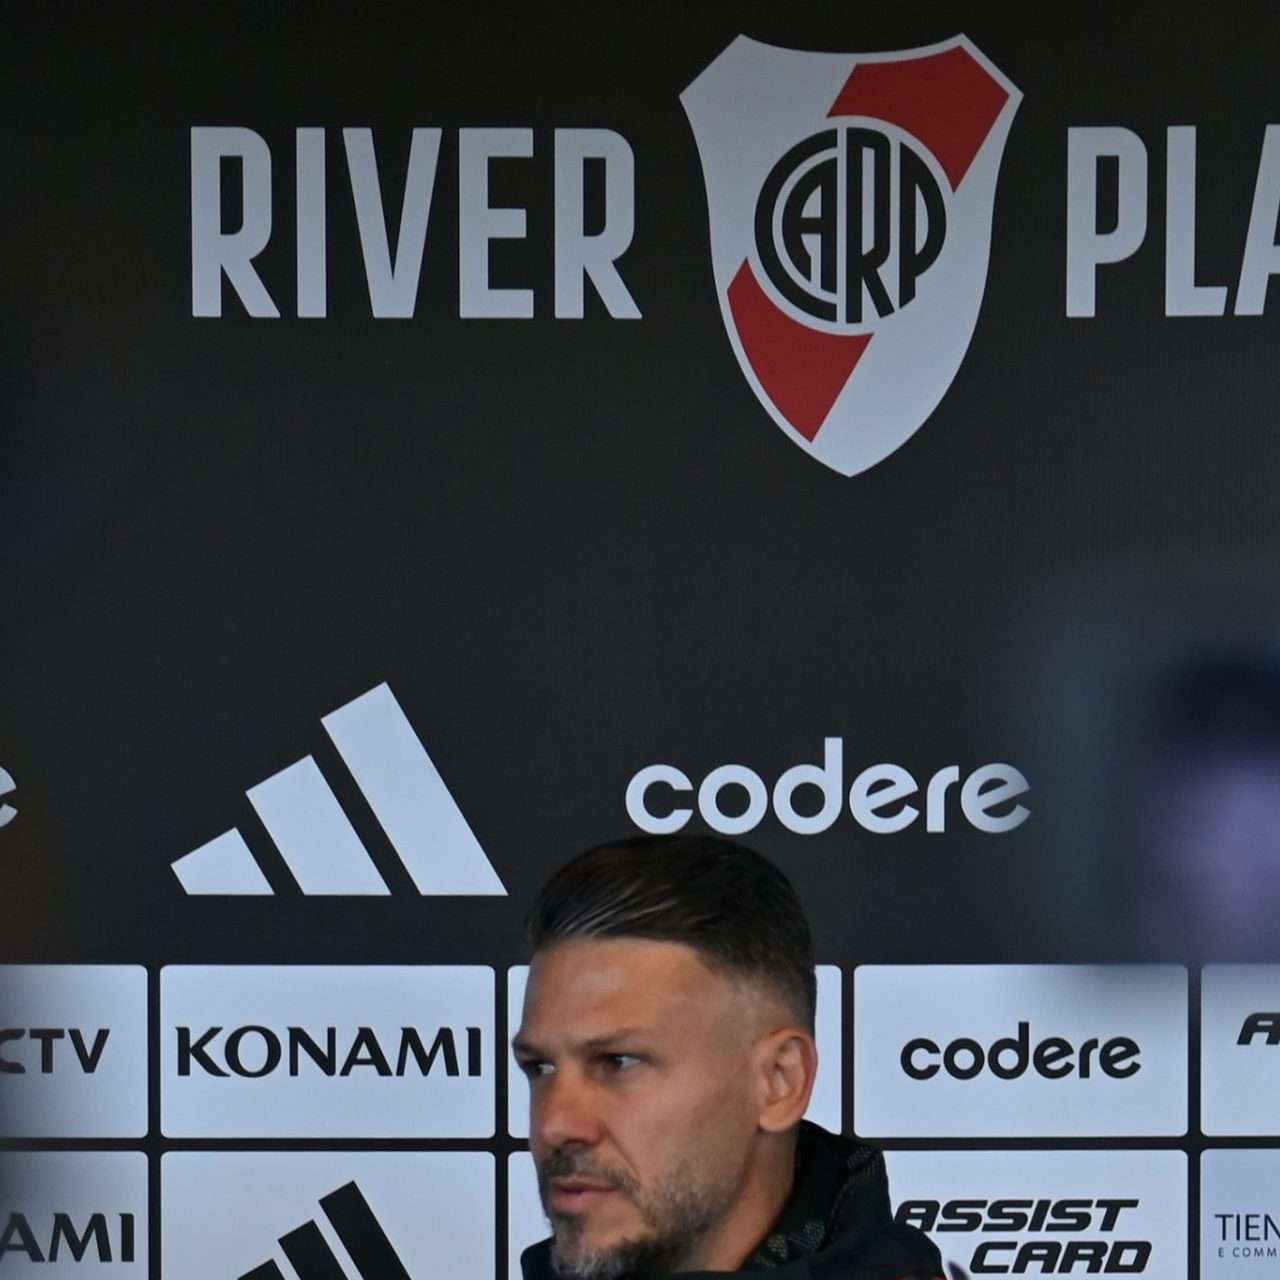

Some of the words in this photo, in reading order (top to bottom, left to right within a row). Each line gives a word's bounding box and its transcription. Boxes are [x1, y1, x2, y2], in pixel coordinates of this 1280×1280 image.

[190, 126, 643, 319] RIVER
[625, 737, 1031, 834] codere
[175, 1024, 482, 1078] KONAMI
[900, 1022, 1141, 1080] codere
[893, 1198, 1140, 1232] ASSIST
[970, 1241, 1153, 1274] CARD
[1217, 1246, 1225, 1258] E
